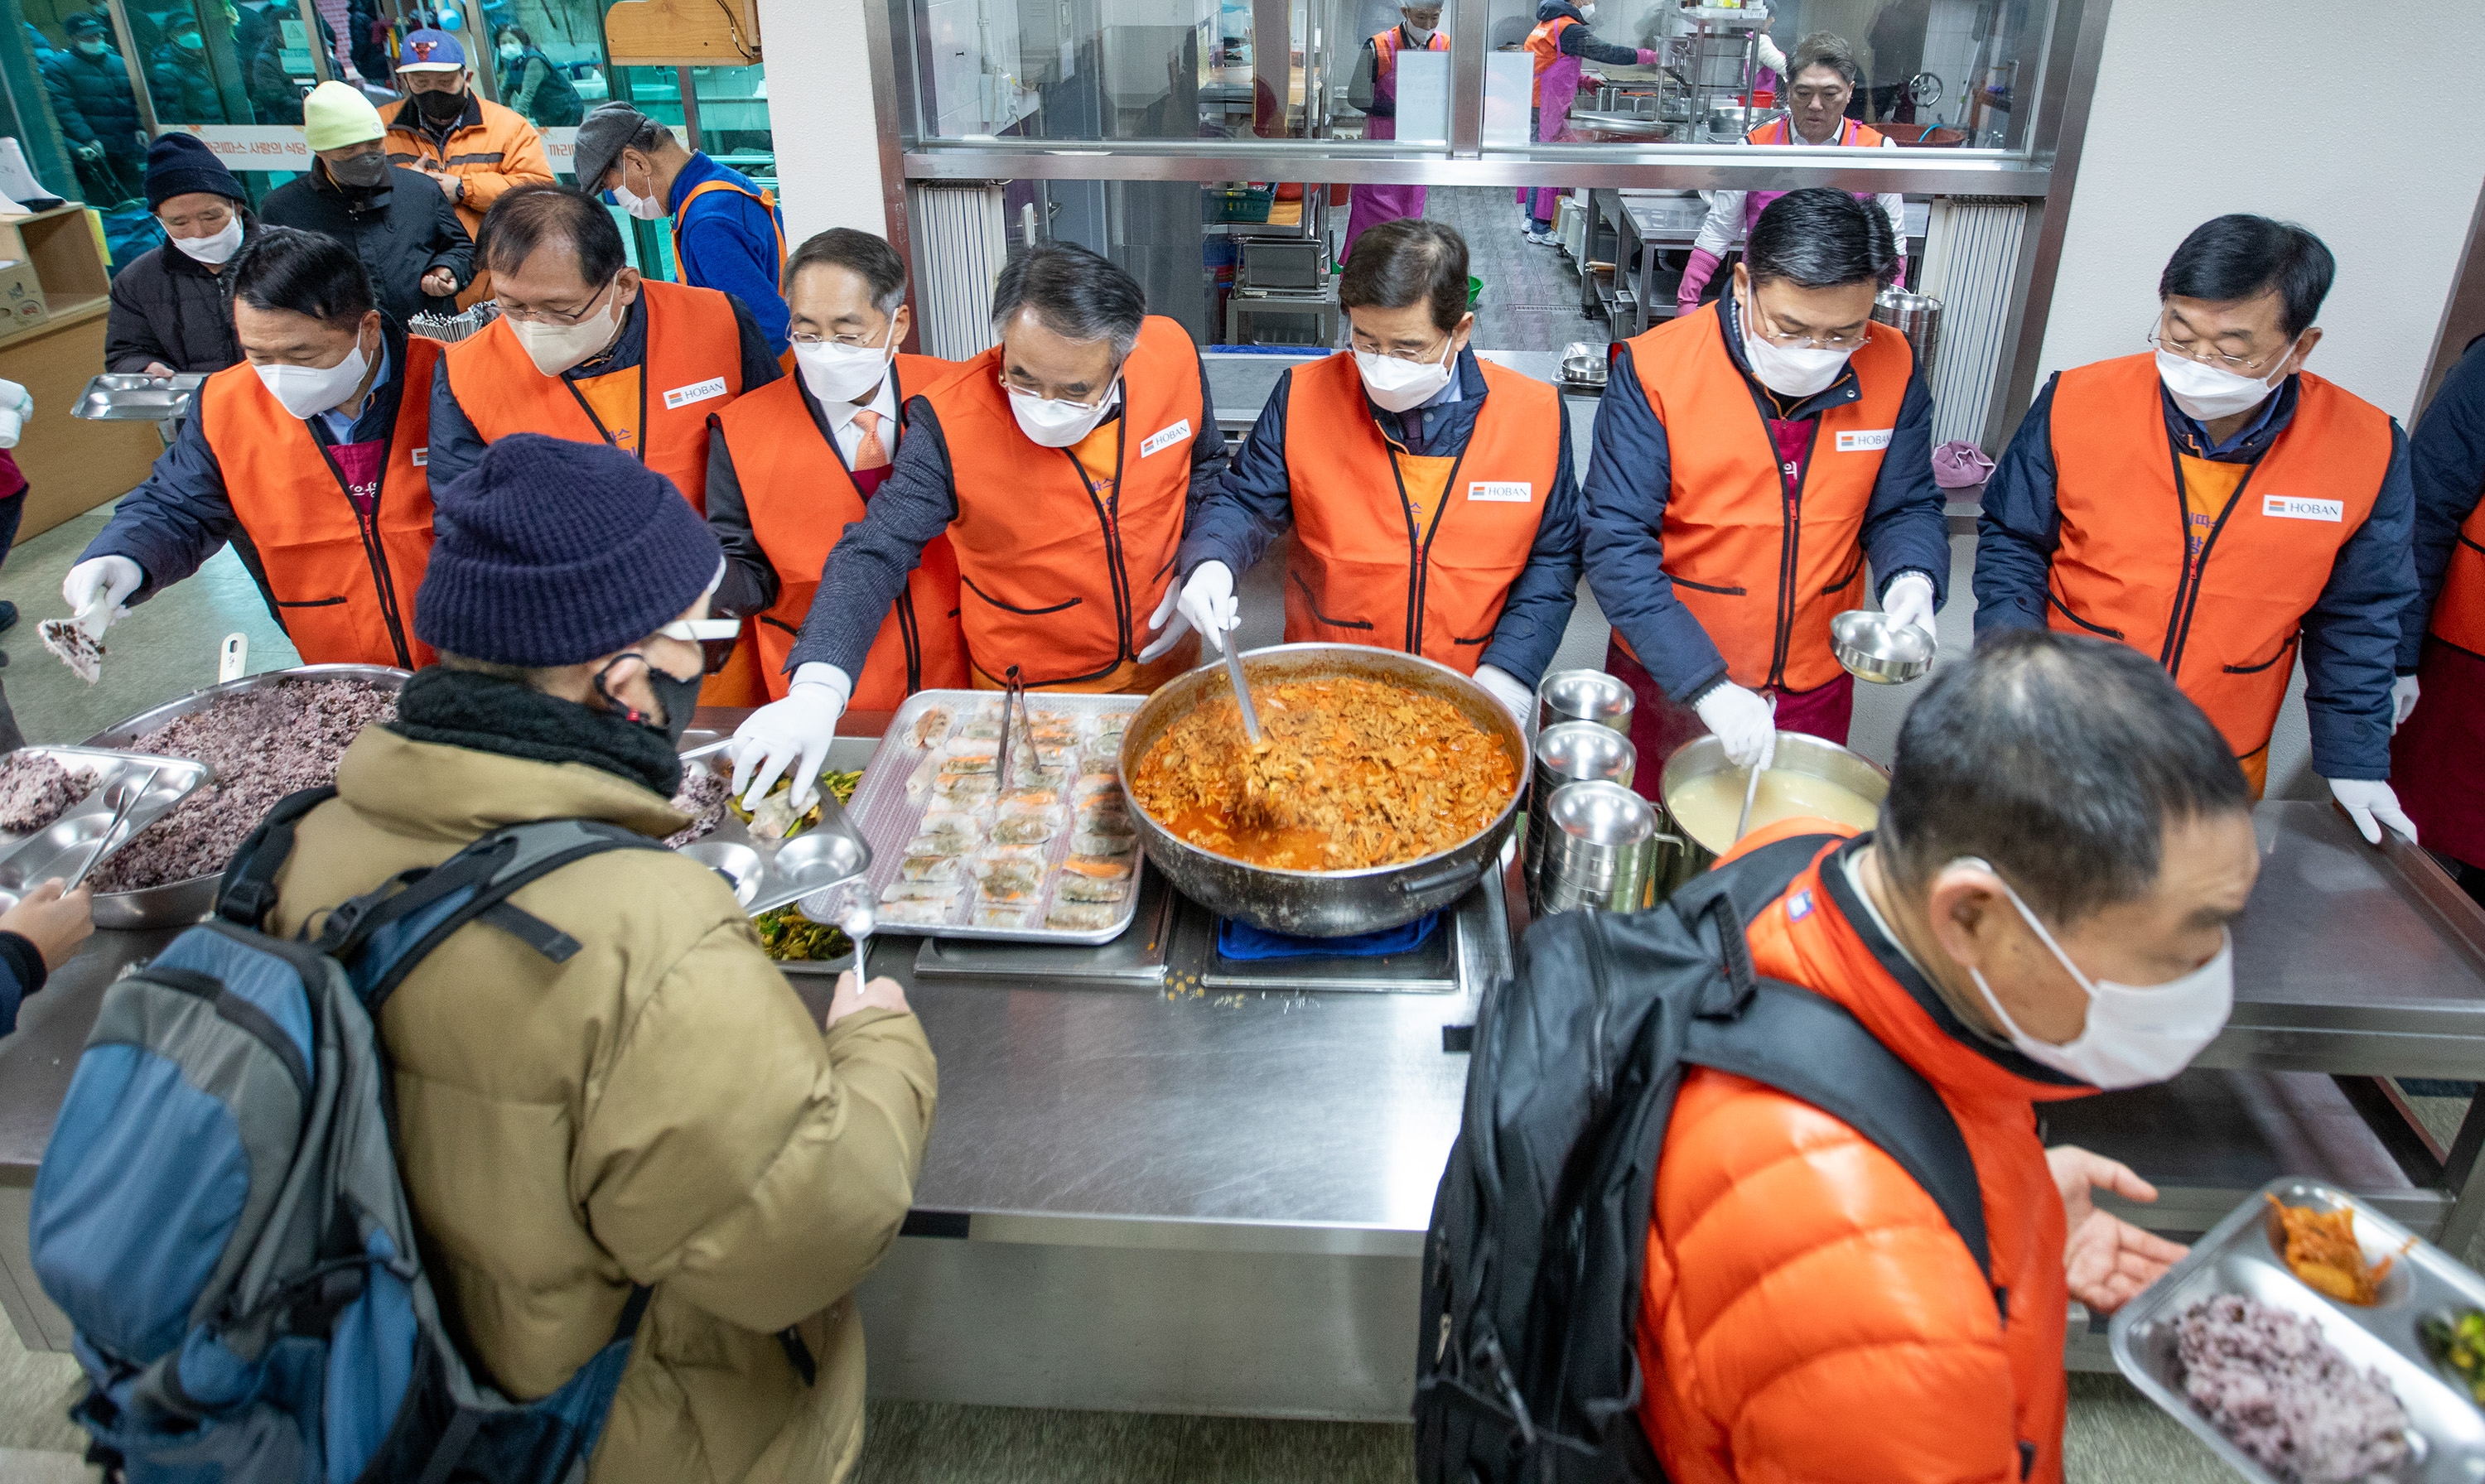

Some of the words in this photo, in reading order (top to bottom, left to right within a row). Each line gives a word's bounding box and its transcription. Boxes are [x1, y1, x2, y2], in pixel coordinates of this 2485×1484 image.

[249, 142, 283, 155] 사랑의
[285, 142, 307, 156] 식당
[684, 382, 724, 399] HOBAN
[1156, 424, 1188, 446] HOBAN
[1858, 435, 1890, 446] HOBAN
[1489, 487, 1528, 497] HOBAN
[2290, 502, 2339, 515] HOBAN
